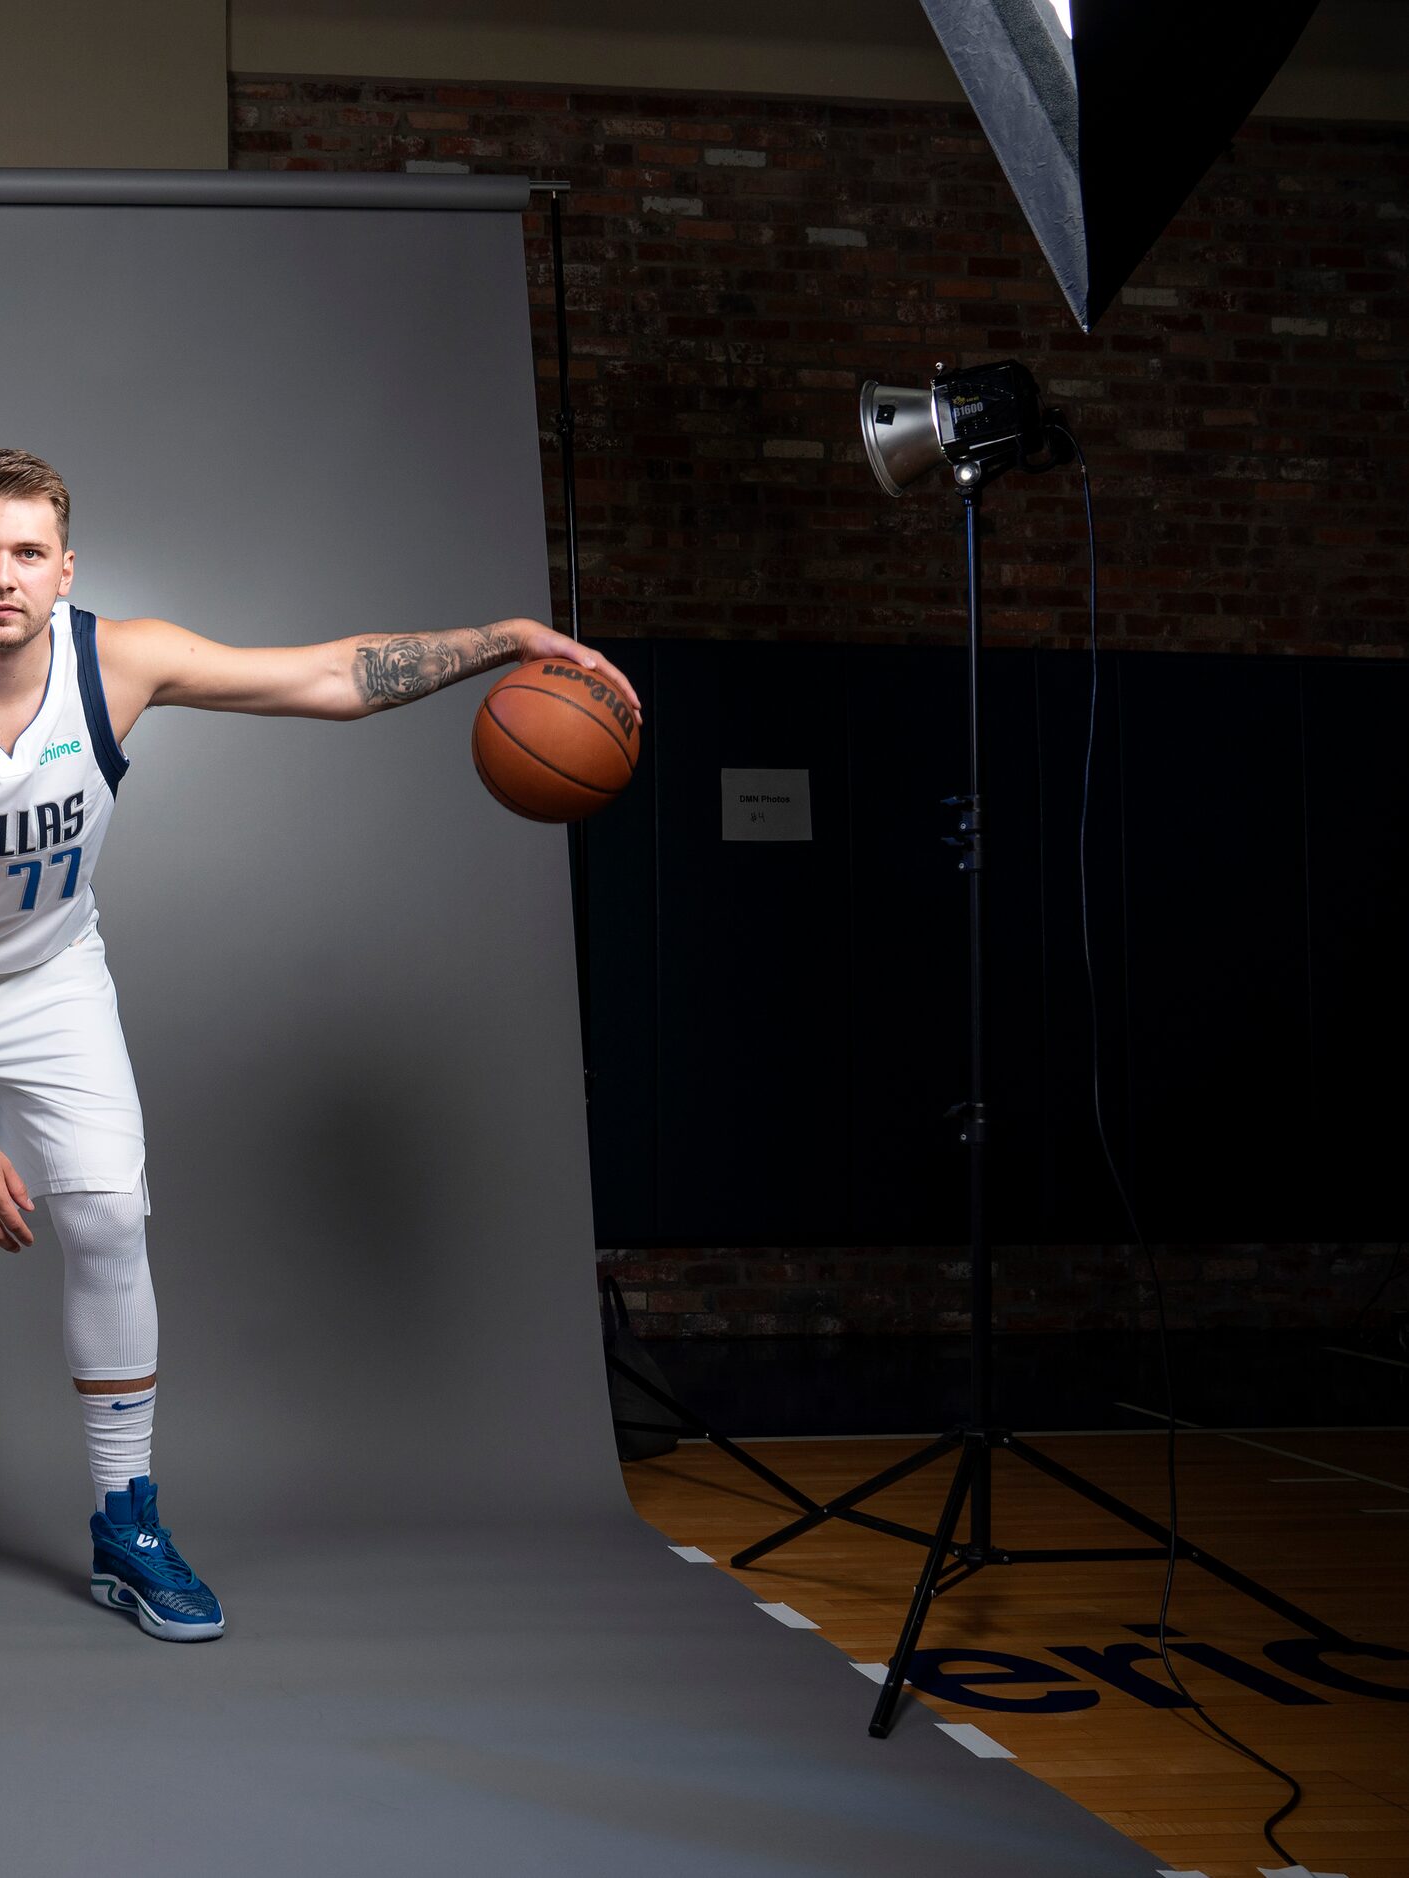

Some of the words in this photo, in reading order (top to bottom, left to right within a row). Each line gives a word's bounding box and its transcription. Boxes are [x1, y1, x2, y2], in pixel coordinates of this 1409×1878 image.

[40, 740, 82, 766] chime
[739, 794, 759, 803] DMN
[761, 794, 791, 803] Photos
[6, 846, 83, 911] 77
